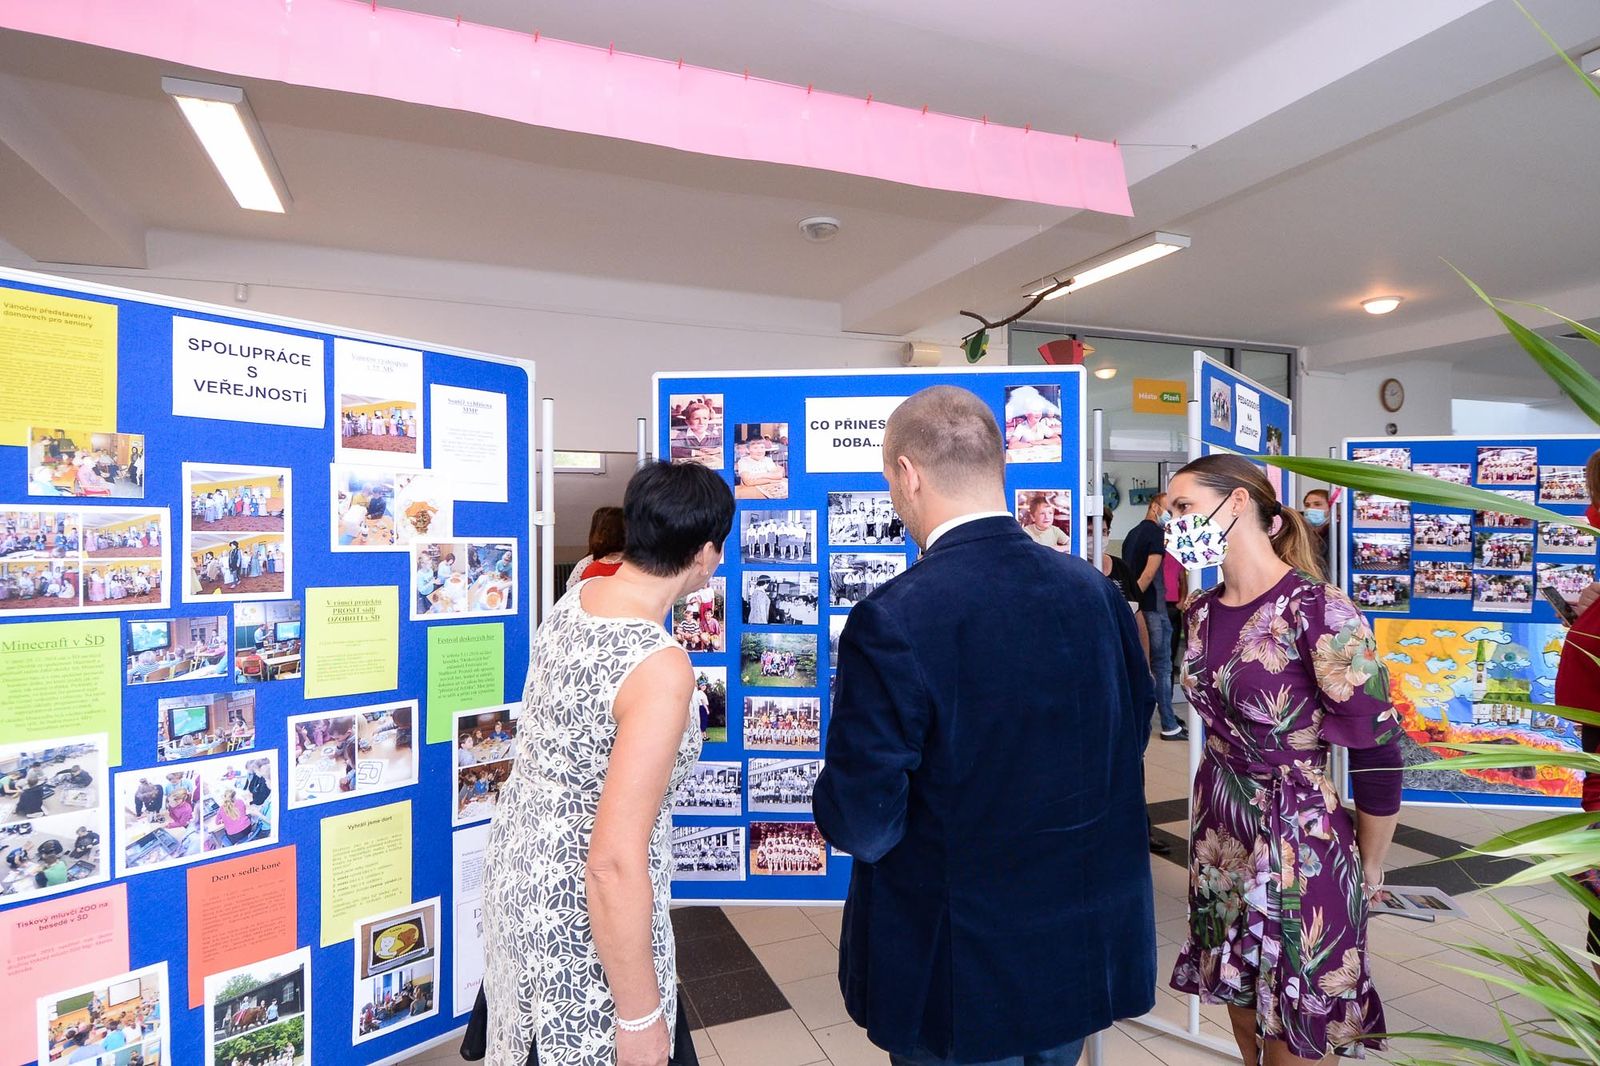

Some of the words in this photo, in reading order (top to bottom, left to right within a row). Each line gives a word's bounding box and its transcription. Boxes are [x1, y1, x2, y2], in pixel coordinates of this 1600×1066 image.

[3, 310, 47, 321] domovech
[49, 317, 62, 325] pro
[64, 319, 93, 329] seniory
[188, 337, 311, 367] SPOLUPRÁCE
[247, 366, 258, 378] S
[194, 379, 307, 403] VEŘEJNOSTÍ
[1163, 393, 1180, 402] Plzeň
[810, 420, 830, 431] CO
[835, 417, 886, 430] PŘINES
[2, 637, 68, 652] Minecraft
[73, 639, 80, 647] v
[84, 634, 105, 646] ŠD
[211, 874, 230, 883] Den
[238, 866, 260, 877] sedle
[17, 916, 49, 929] Tiskový
[50, 909, 78, 920] mluvčí
[79, 903, 97, 913] ZOO
[38, 918, 69, 931] besedě
